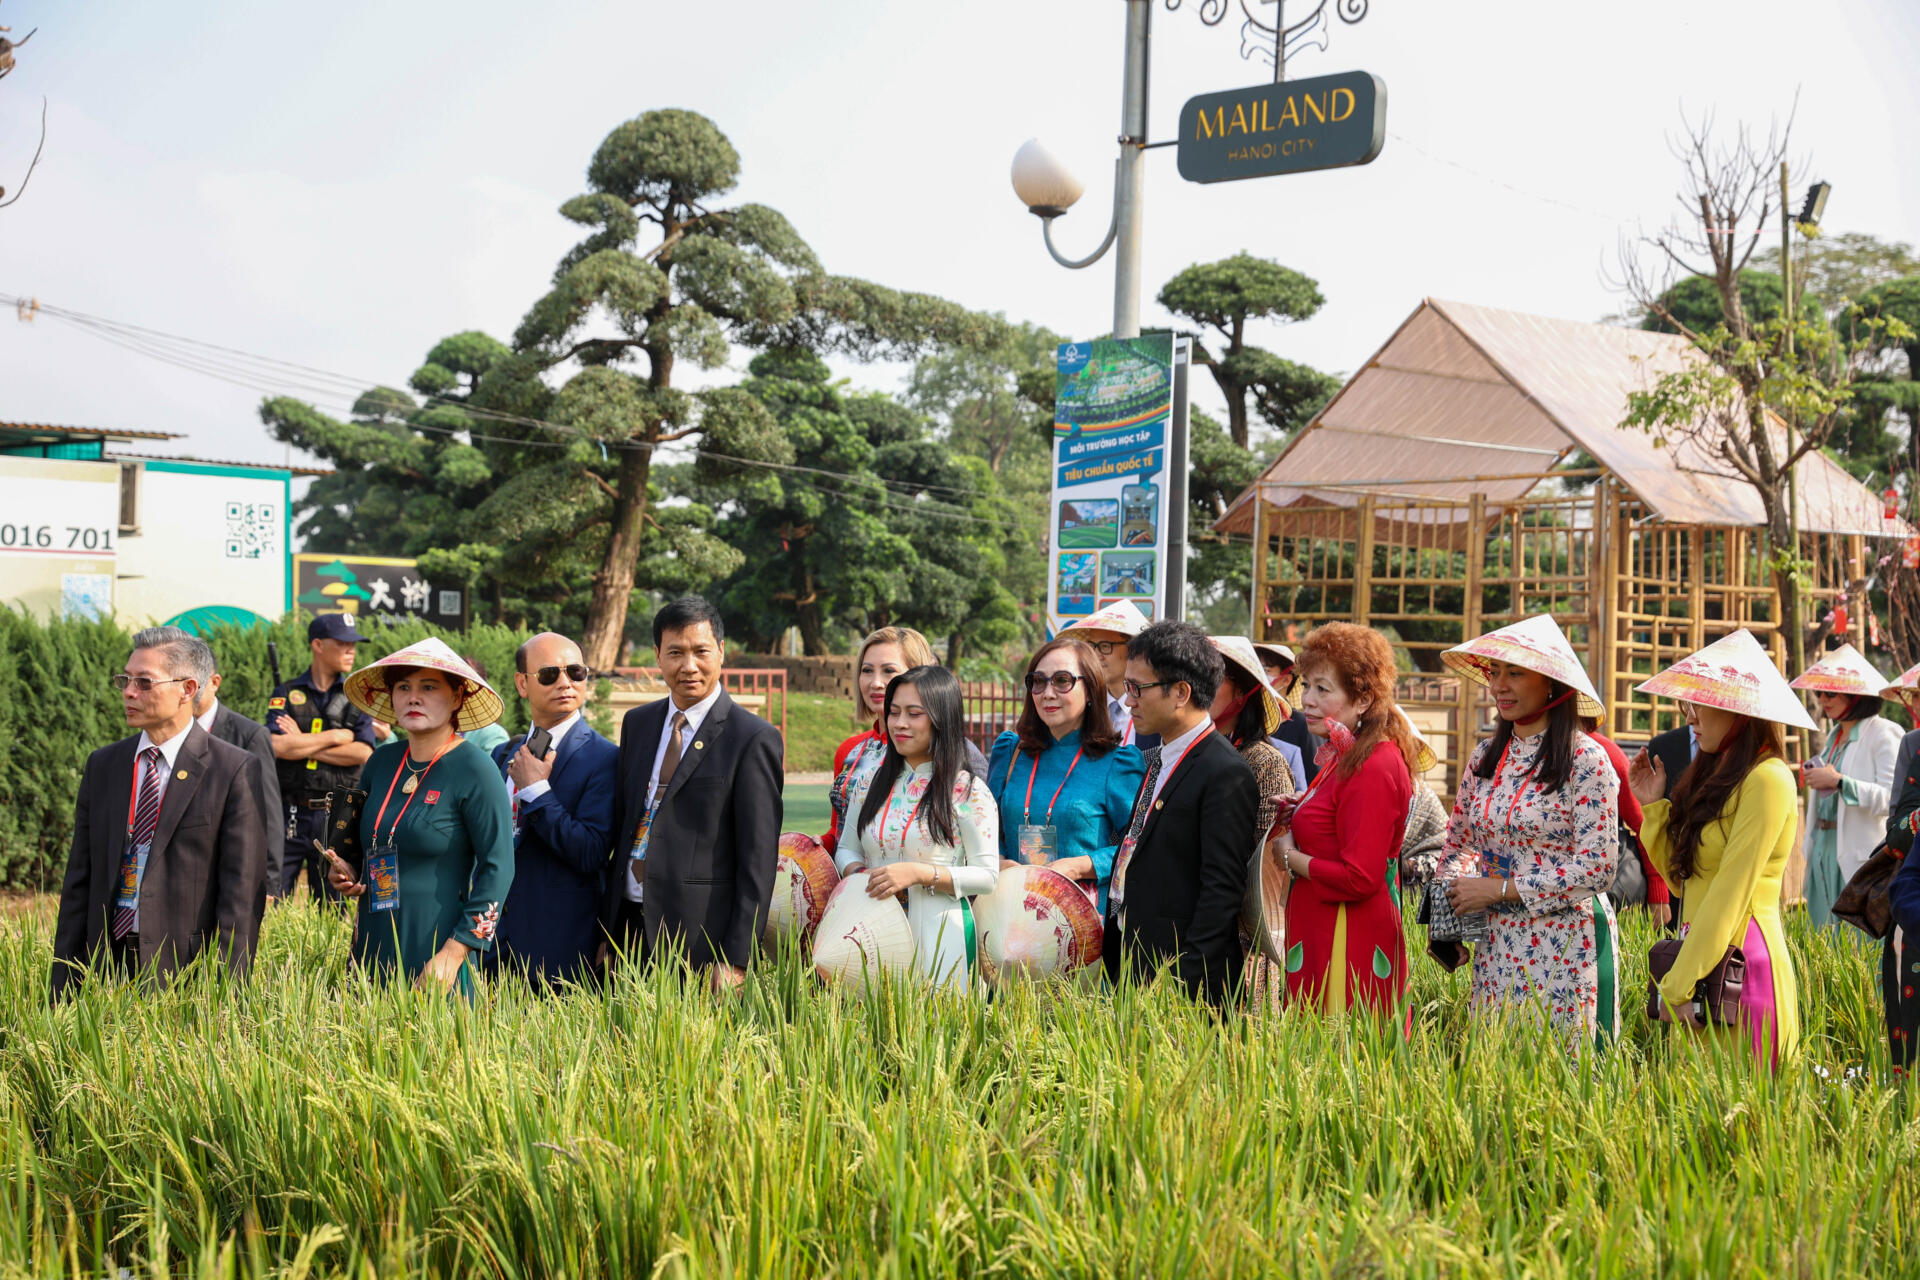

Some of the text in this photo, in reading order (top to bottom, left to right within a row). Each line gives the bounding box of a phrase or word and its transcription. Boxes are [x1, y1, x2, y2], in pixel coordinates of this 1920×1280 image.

[1195, 87, 1356, 141] MAILAND
[1228, 138, 1317, 161] HANOI CITY
[1119, 434, 1134, 446] HỌC
[1065, 468, 1083, 481] TIÊU
[1116, 455, 1141, 473] QUỐC
[1, 524, 113, 550] 016 701
